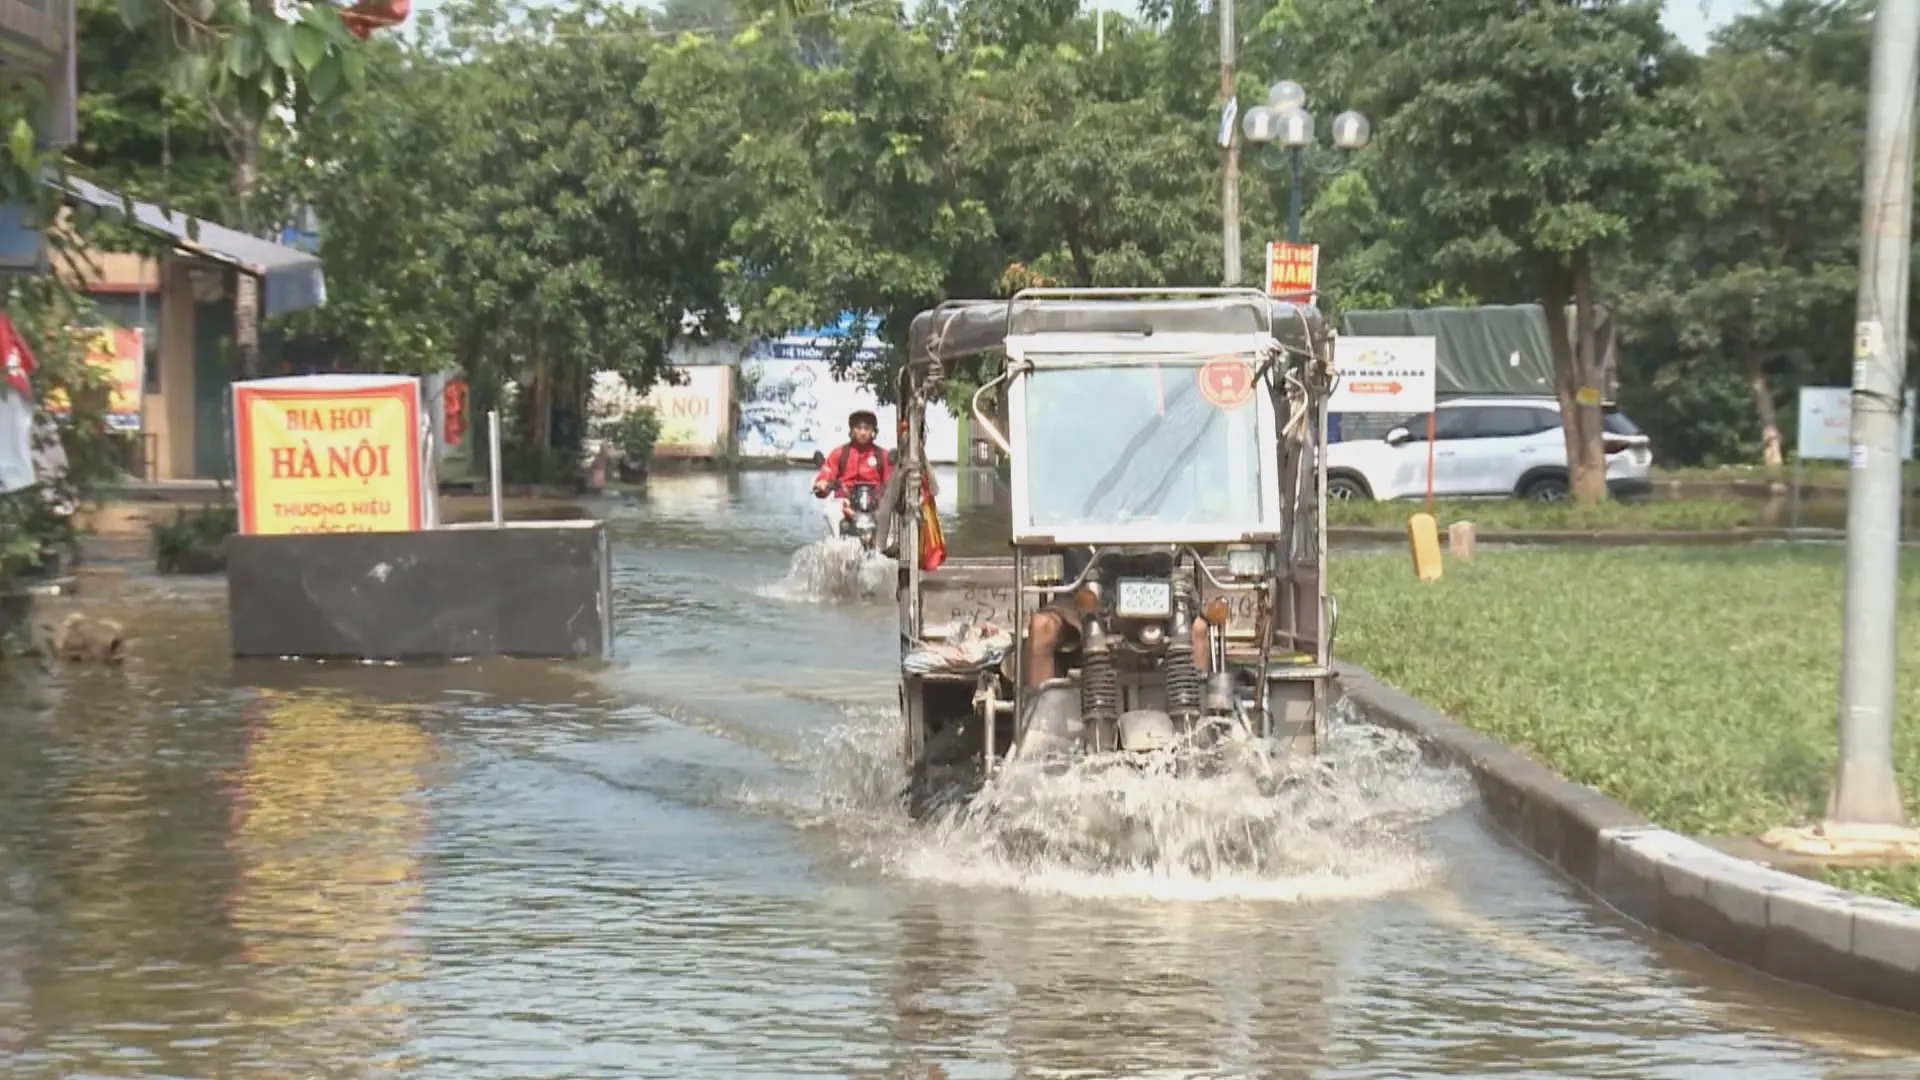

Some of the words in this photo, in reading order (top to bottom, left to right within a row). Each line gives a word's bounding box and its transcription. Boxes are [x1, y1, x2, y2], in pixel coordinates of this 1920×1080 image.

[1271, 263, 1313, 283] NAM
[285, 408, 324, 431] BIA
[329, 407, 373, 431] HƠI
[270, 438, 321, 480] HÀ
[327, 437, 391, 486] NỘI
